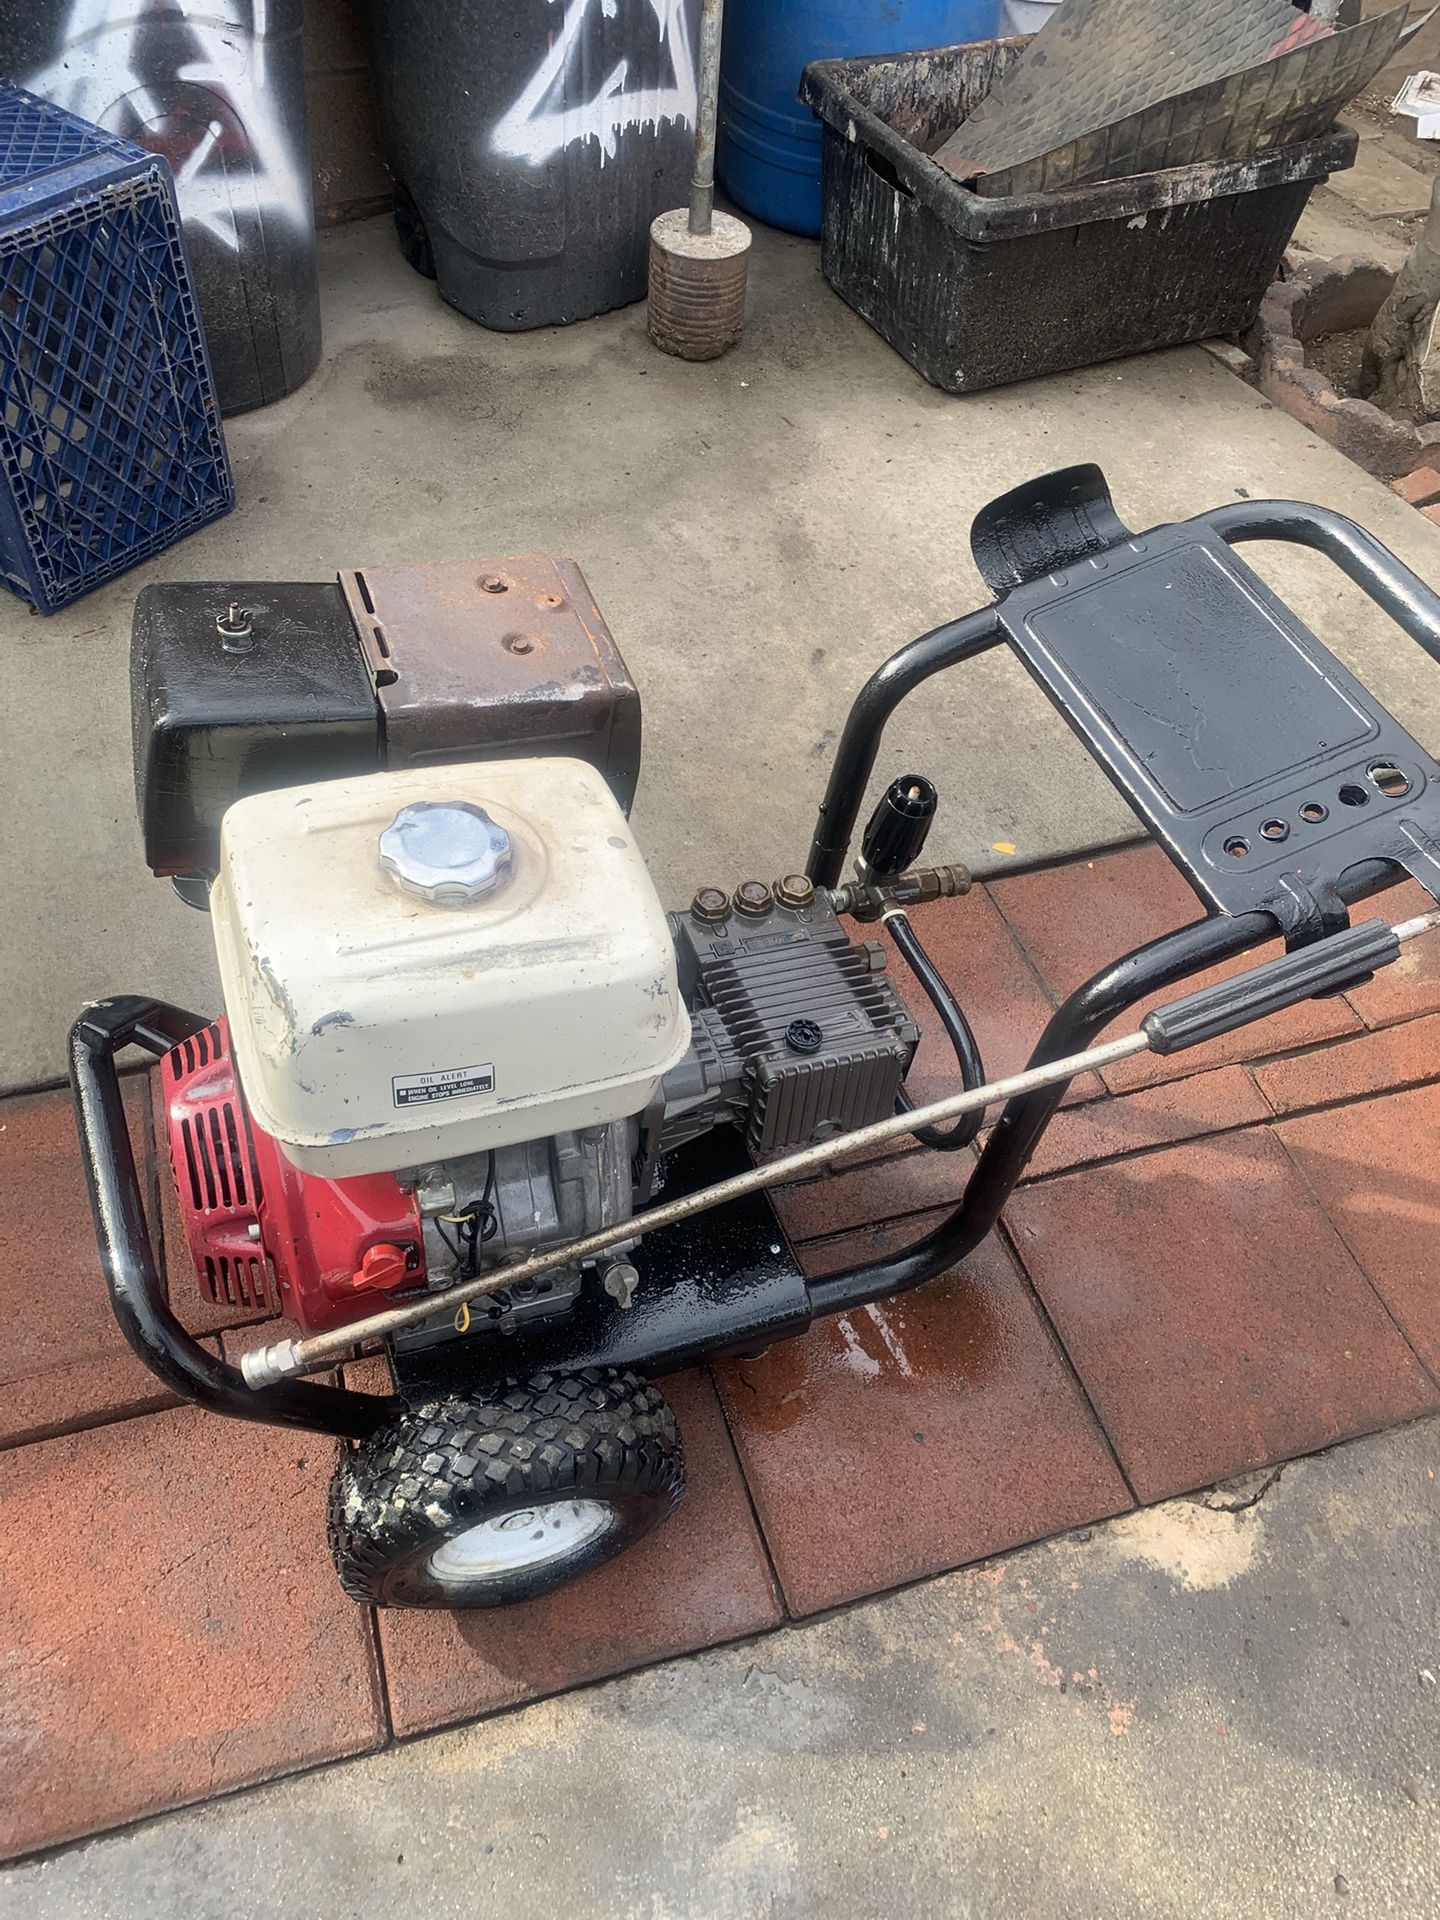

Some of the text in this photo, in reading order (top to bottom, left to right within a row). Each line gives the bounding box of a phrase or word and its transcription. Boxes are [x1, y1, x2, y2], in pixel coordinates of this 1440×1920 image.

[420, 1071, 468, 1085] OIL ALERT
[407, 1088, 426, 1096] WHEN
[440, 1083, 457, 1091] LEVEL
[408, 1094, 429, 1102] ENGINE
